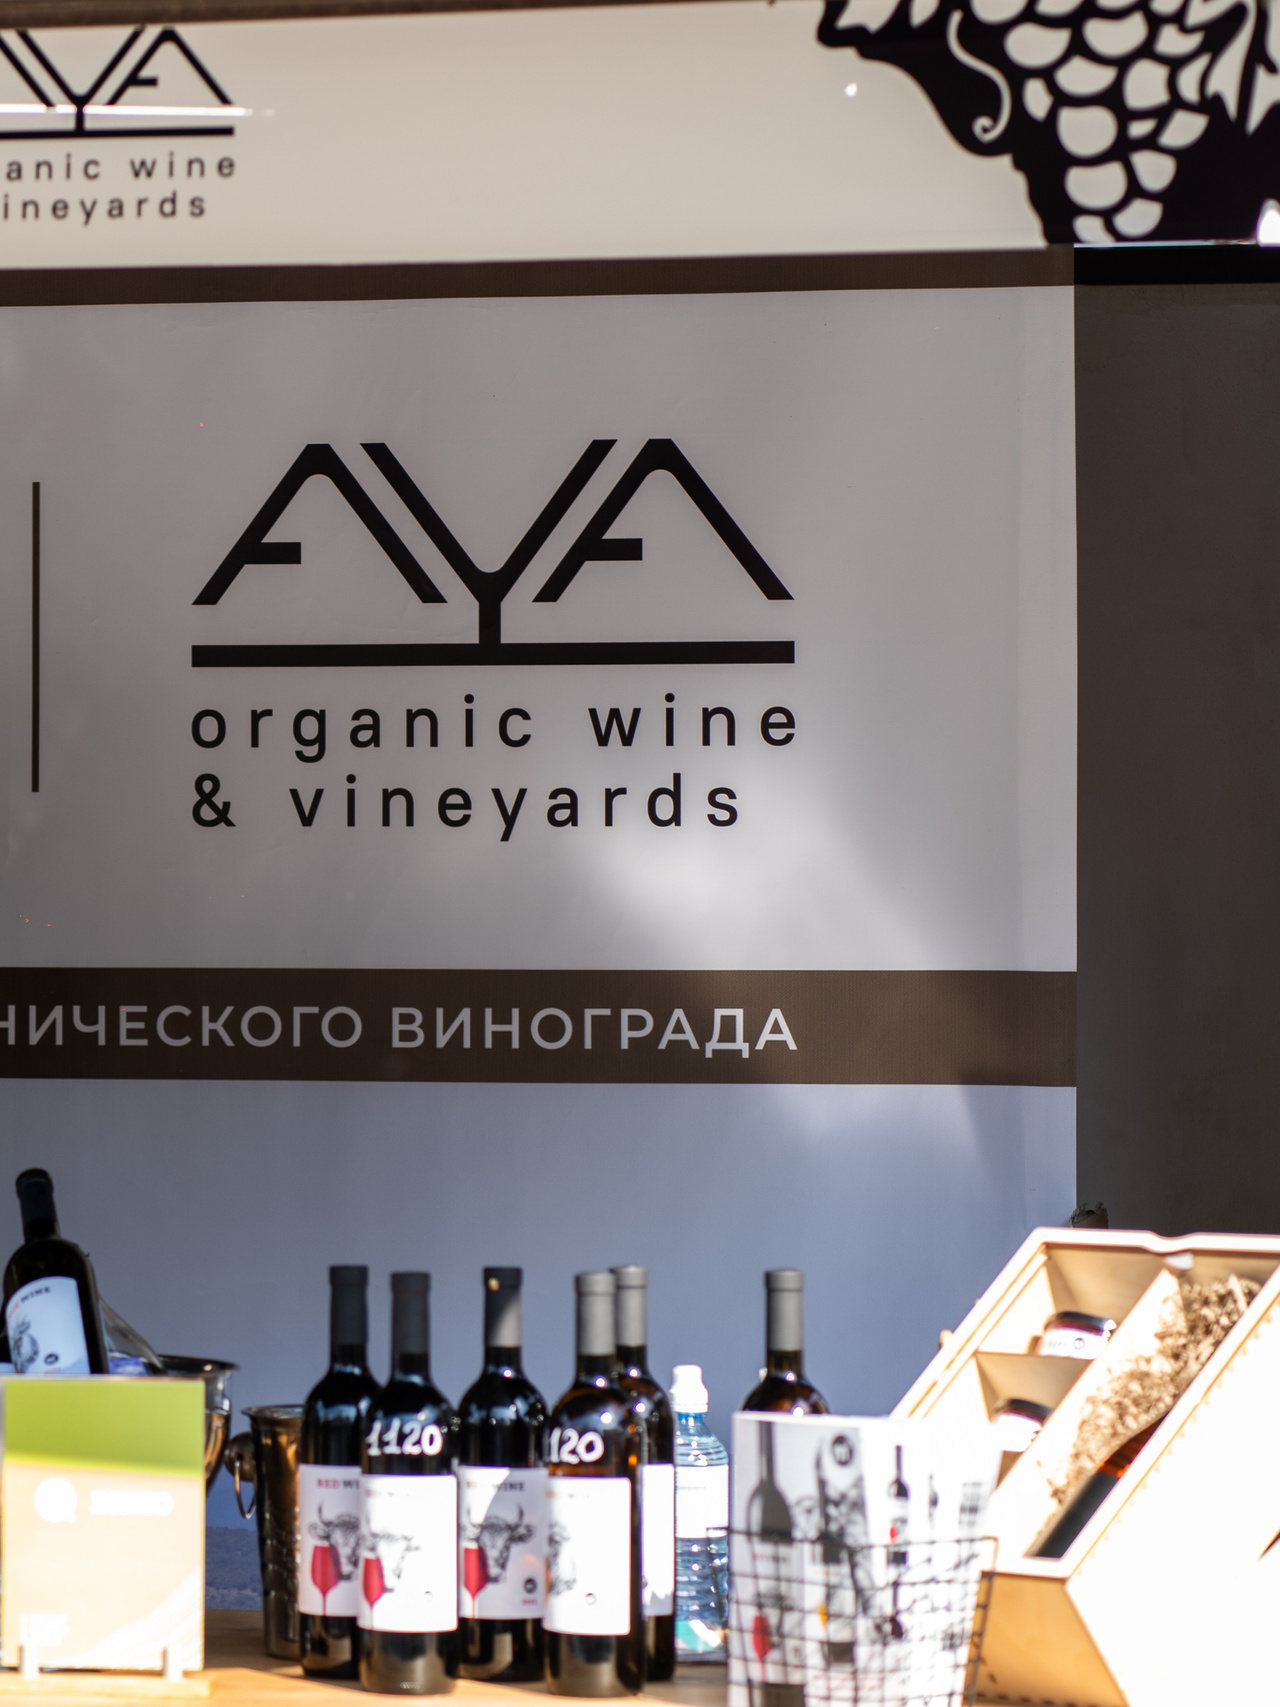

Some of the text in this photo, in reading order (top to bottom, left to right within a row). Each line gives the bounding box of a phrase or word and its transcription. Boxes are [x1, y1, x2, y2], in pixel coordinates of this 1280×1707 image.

[130, 151, 235, 180] wine
[191, 692, 797, 764] organic wine
[191, 772, 740, 842] & vineyards
[391, 1007, 798, 1059] ВИНОГРАДА
[366, 1417, 443, 1456] 1120
